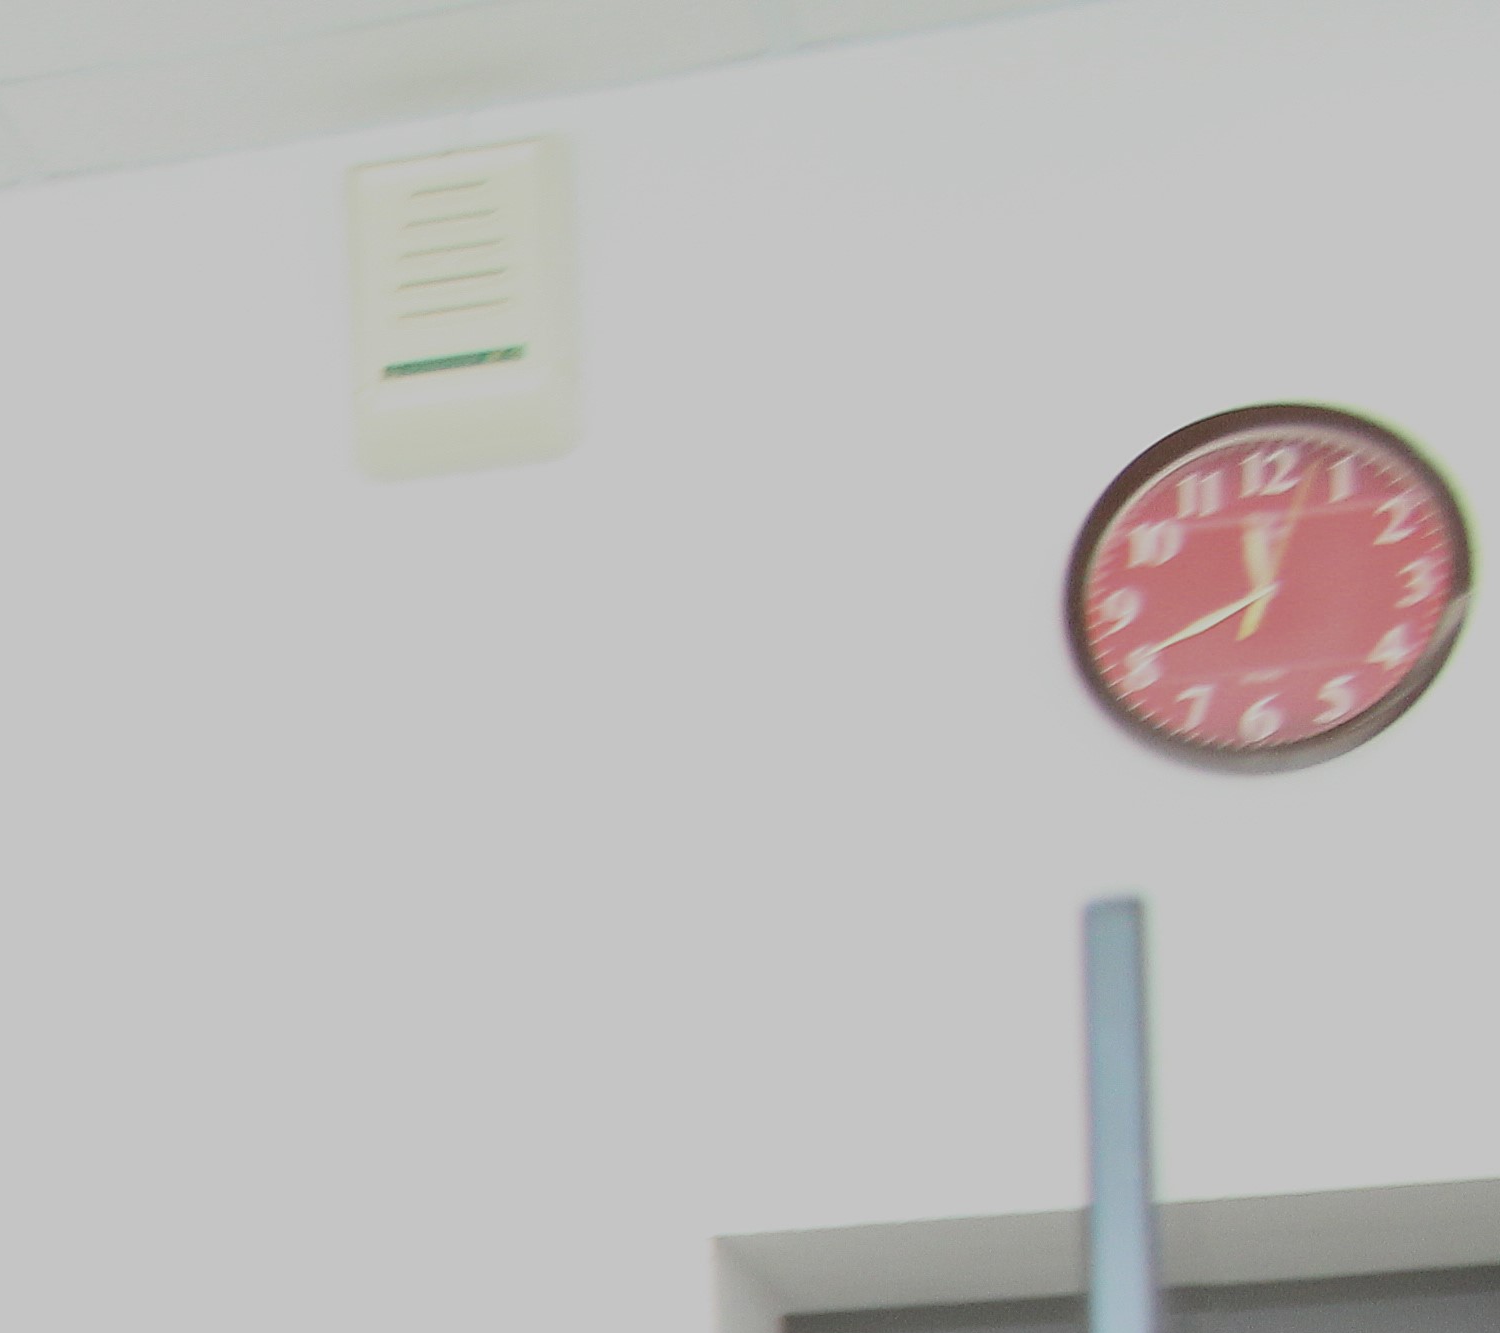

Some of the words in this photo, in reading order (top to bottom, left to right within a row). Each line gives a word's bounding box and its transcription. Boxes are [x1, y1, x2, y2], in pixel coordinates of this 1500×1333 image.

[1176, 471, 1227, 519] 11
[1239, 447, 1302, 499] 12
[1328, 453, 1358, 503] 1
[1127, 521, 1185, 568] 10
[1373, 495, 1424, 546] 2
[1394, 557, 1442, 609] 3
[1100, 588, 1143, 634] 9
[1122, 647, 1161, 690] 8
[1367, 625, 1412, 671] 4
[1176, 684, 1216, 730] 7
[1237, 693, 1282, 744] 6
[1313, 675, 1356, 726] 5
